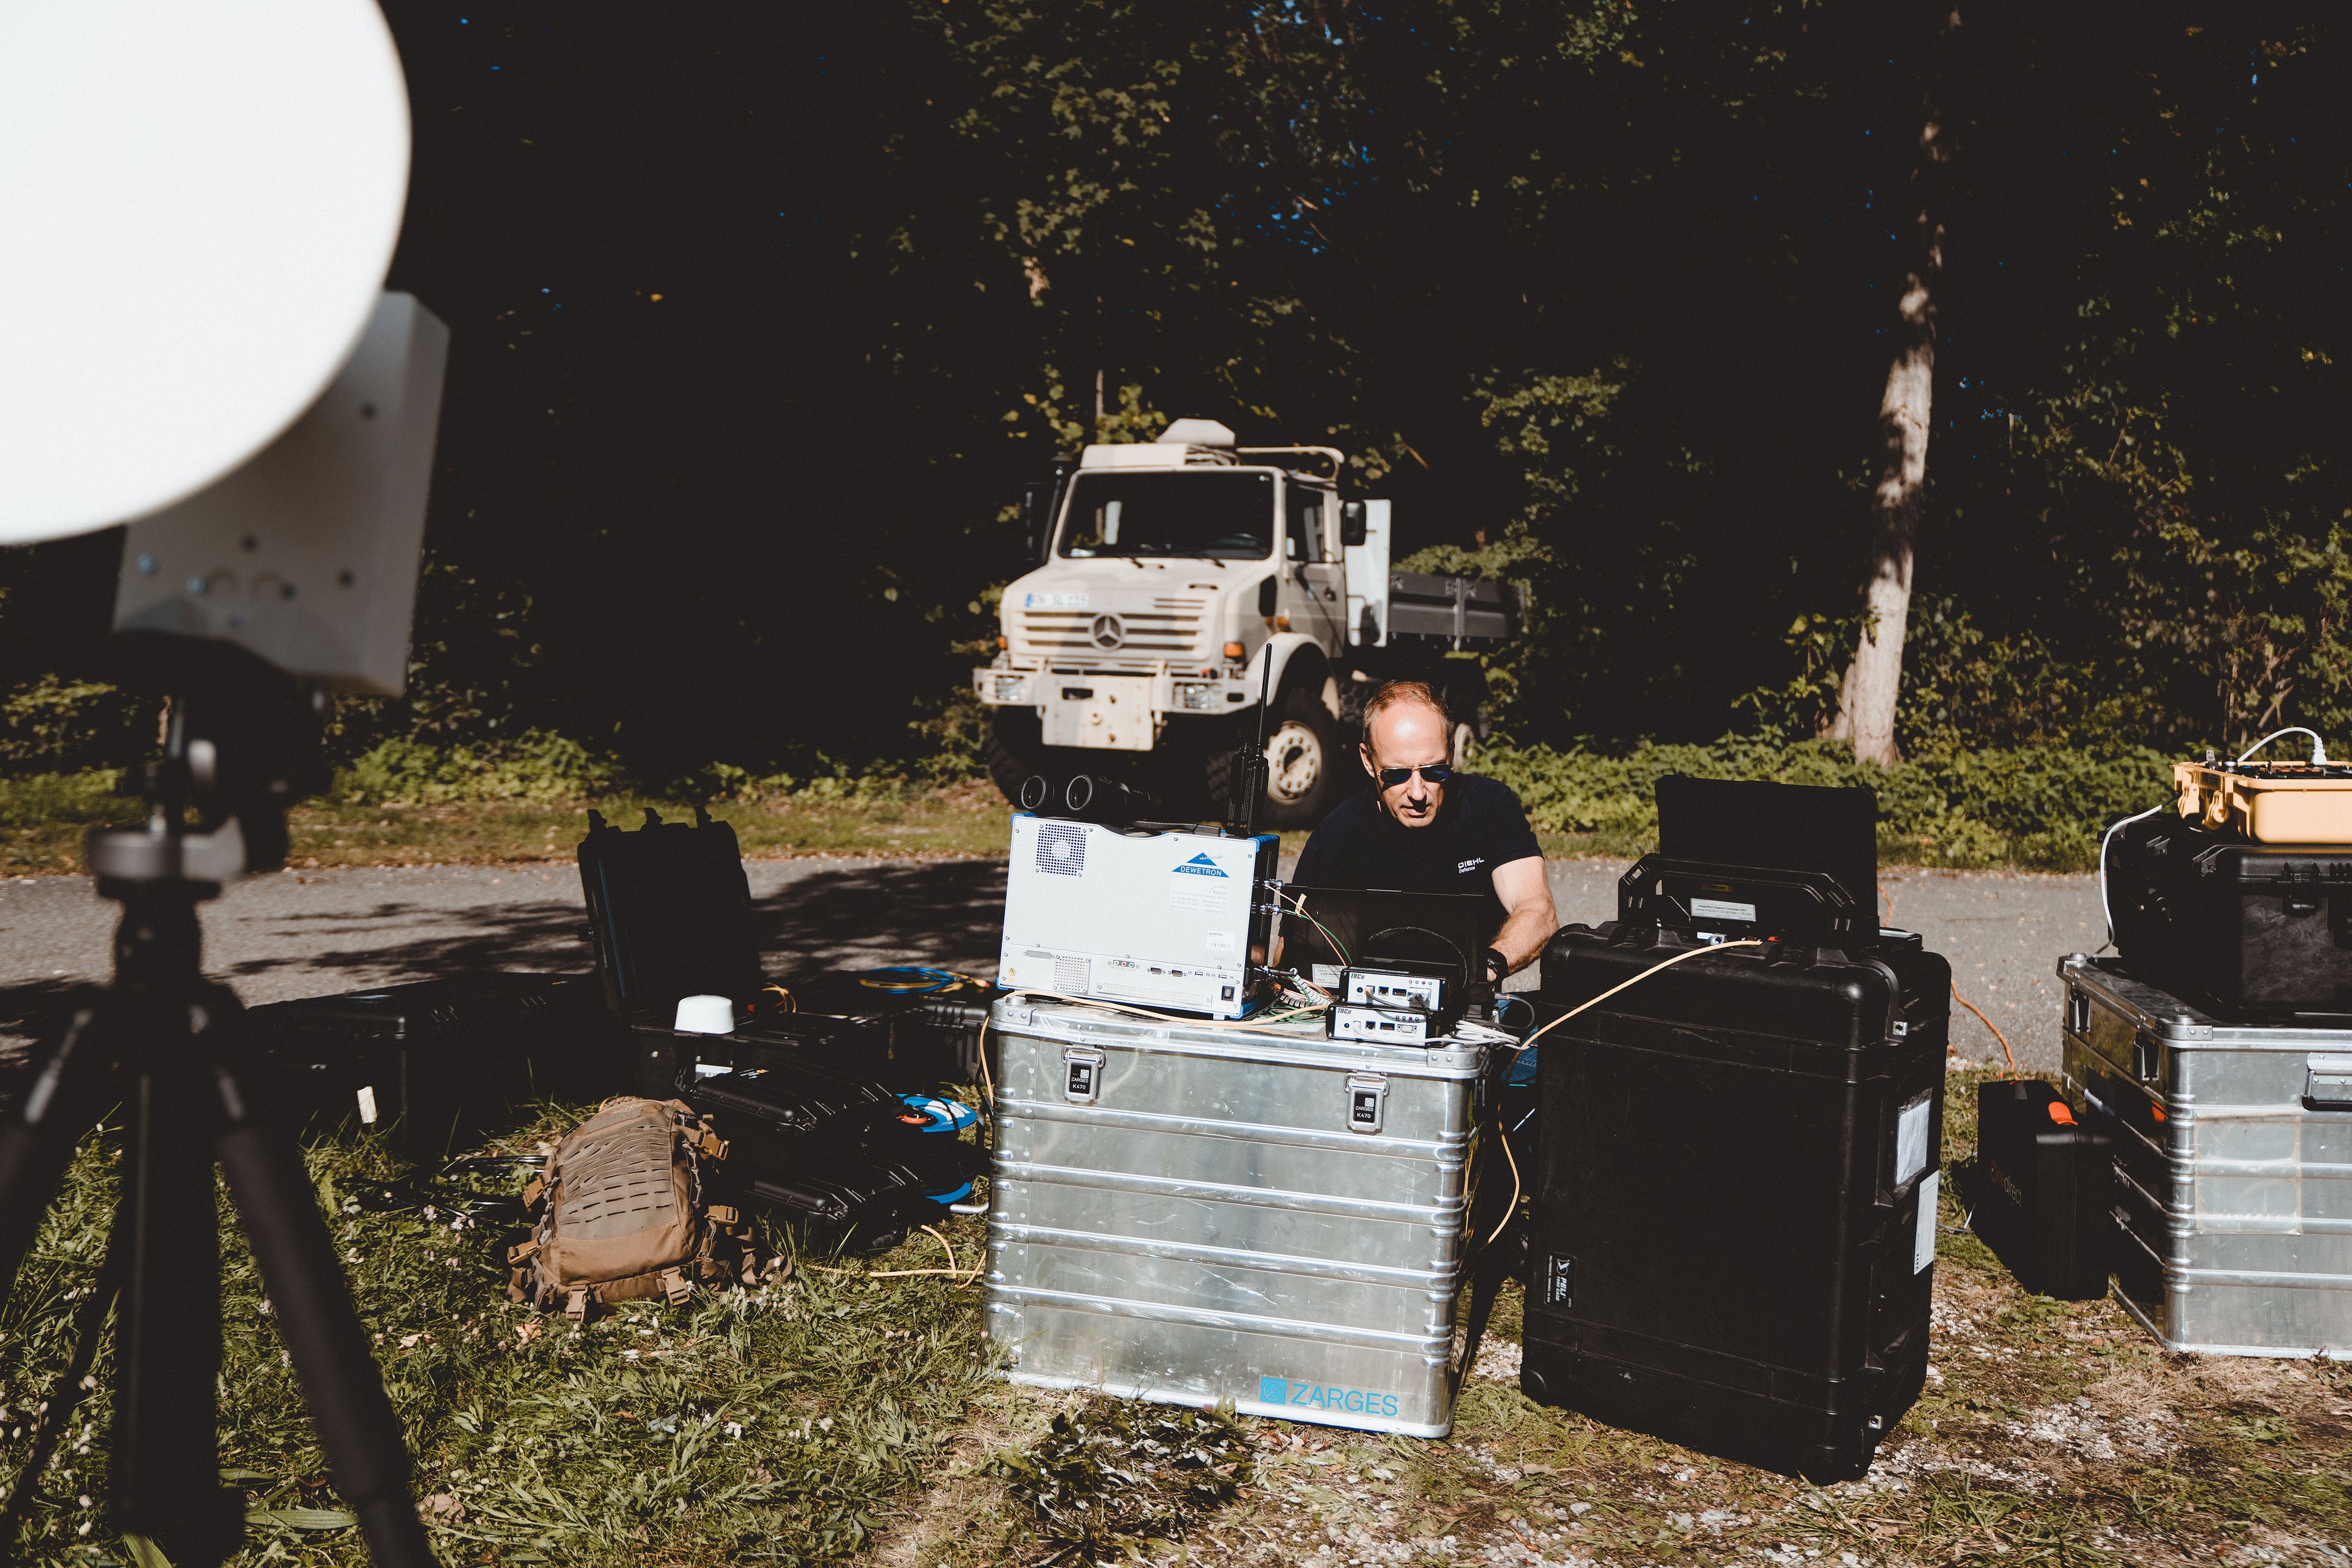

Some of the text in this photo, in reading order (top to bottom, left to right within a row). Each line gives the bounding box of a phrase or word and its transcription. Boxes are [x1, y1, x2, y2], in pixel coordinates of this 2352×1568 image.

[1458, 857, 1484, 869] DIEHL
[1180, 866, 1222, 876] DEWETRON
[1291, 1383, 1398, 1417] ZARGES
